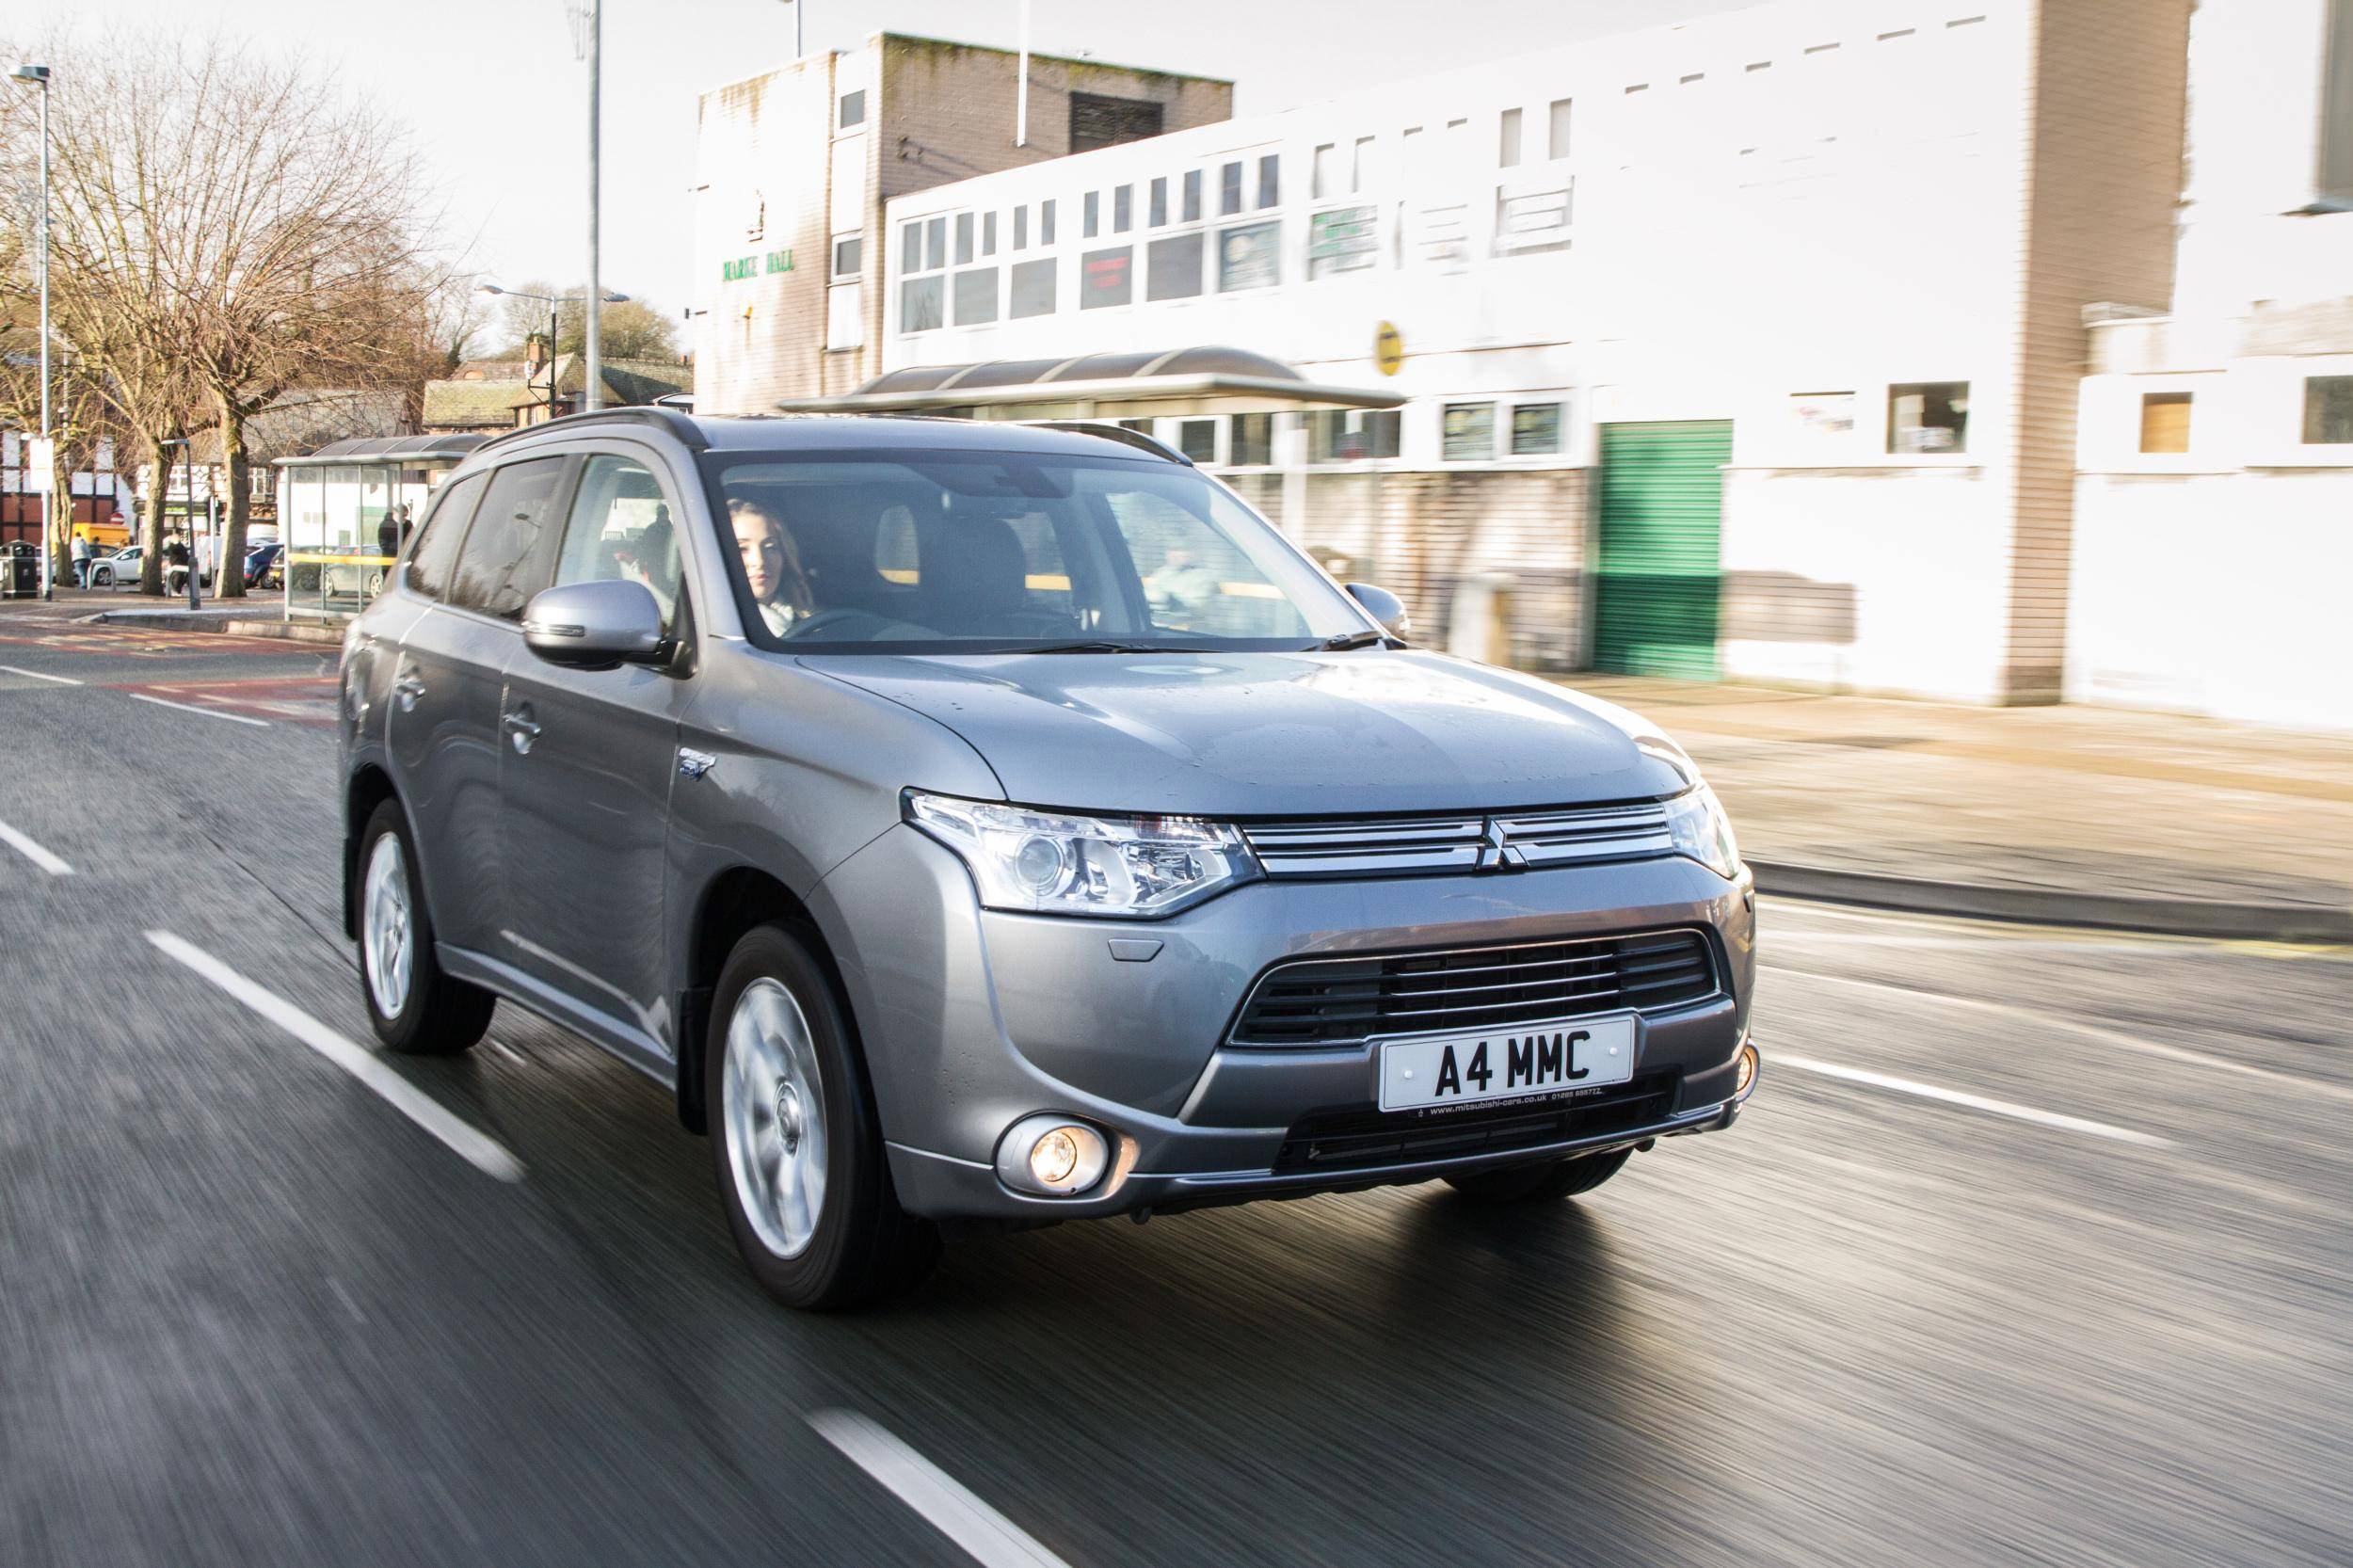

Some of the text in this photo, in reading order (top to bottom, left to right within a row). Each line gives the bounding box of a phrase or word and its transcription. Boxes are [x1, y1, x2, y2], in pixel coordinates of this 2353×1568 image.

[766, 248, 795, 274] HALL
[1434, 1030, 1591, 1097] A4 MMC
[1430, 1094, 1547, 1115] www.mitsubishi-cars.co.uk
